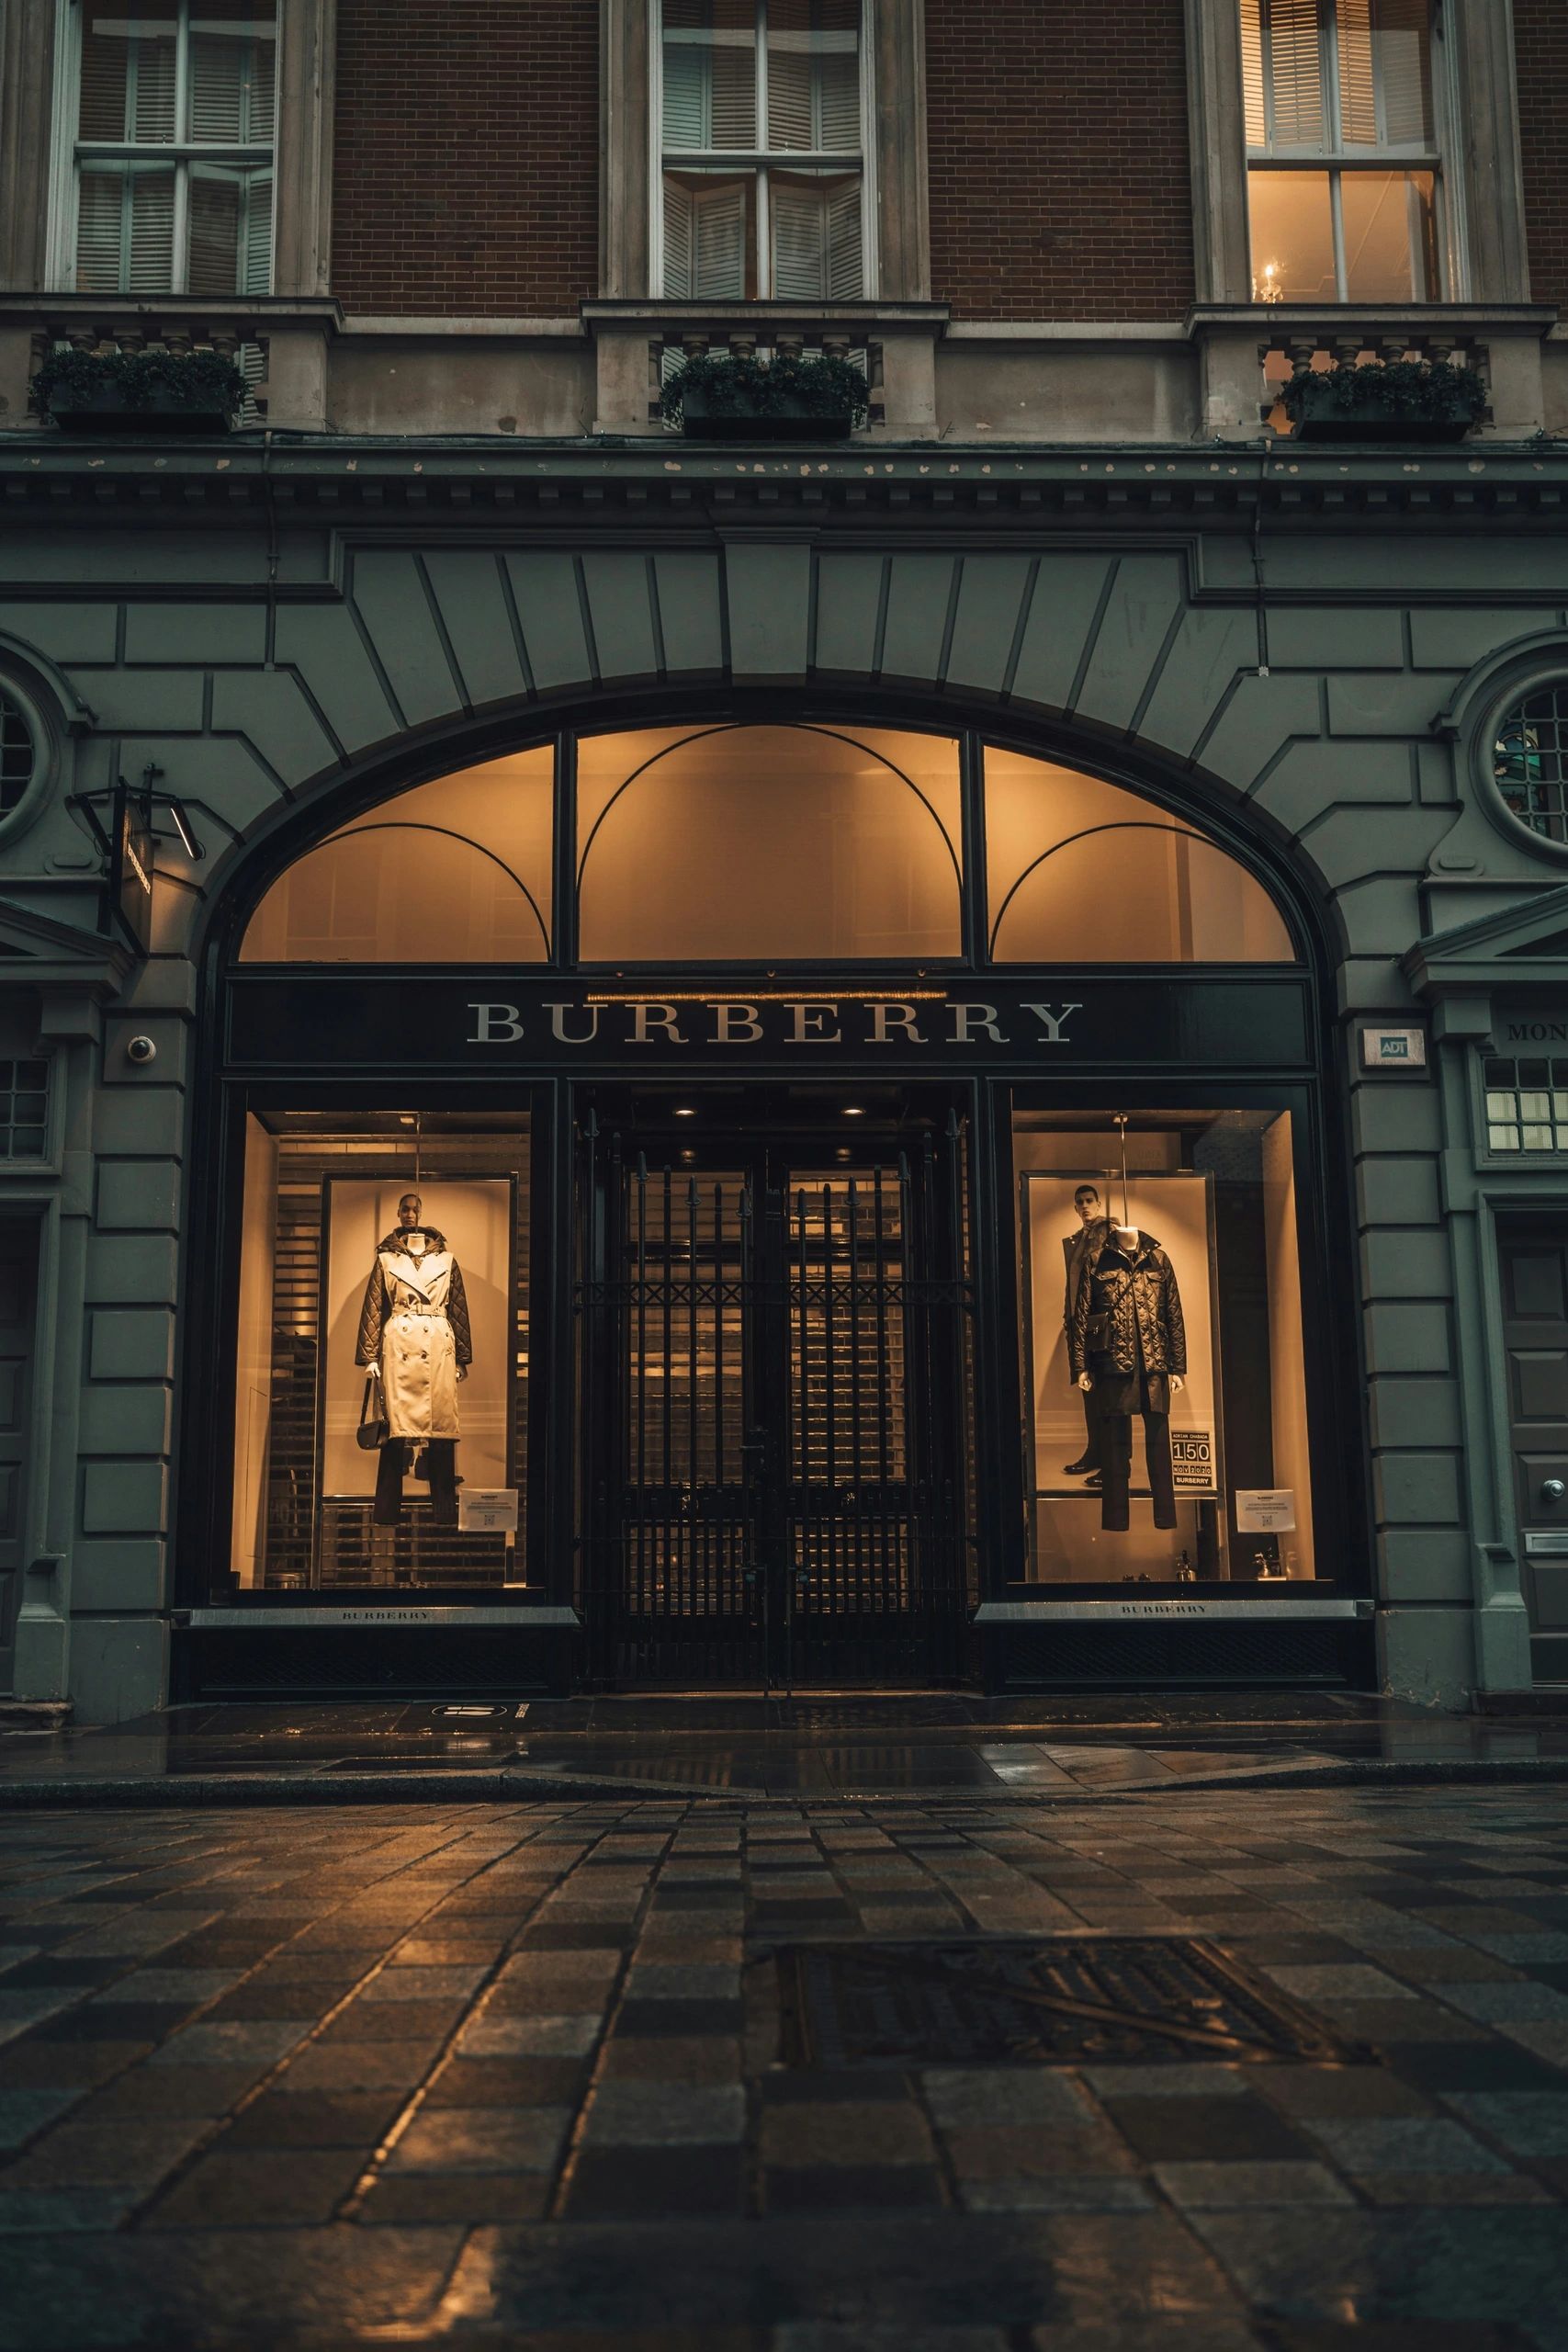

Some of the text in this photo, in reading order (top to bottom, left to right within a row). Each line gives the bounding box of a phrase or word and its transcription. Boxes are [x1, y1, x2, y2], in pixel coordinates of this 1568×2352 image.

[467, 1003, 1083, 1044] BURBERRY
[1381, 1041, 1407, 1055] ADT
[1173, 1443, 1210, 1461] 150
[1122, 1605, 1206, 1613] BURBERRY
